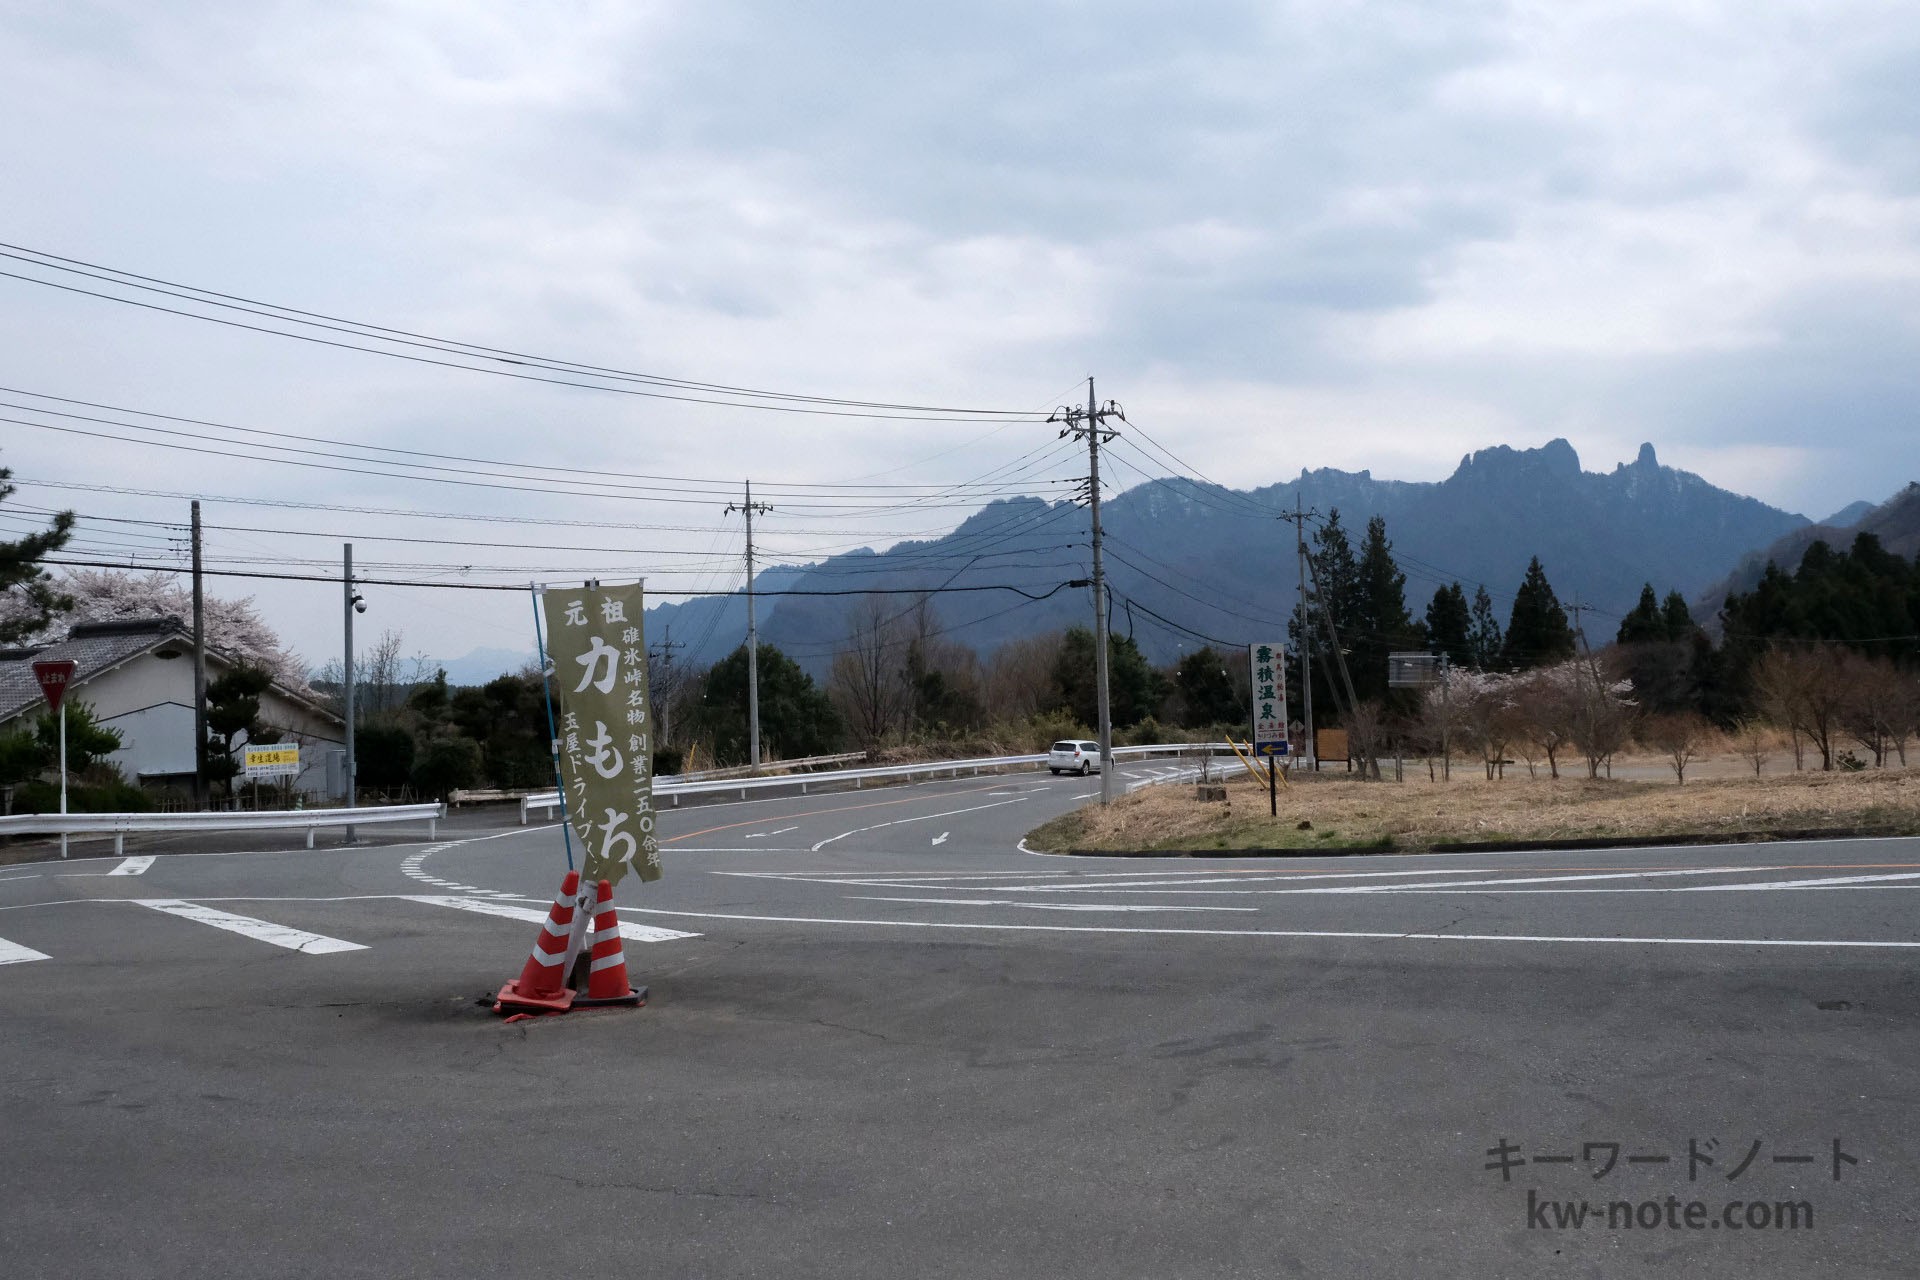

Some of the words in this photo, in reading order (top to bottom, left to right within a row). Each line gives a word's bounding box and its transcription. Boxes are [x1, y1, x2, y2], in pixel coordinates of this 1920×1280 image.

[564, 597, 628, 626] 元祖
[42, 672, 66, 684] 止まれ
[1256, 646, 1276, 719] 霧積温泉
[573, 636, 637, 863] 力もち
